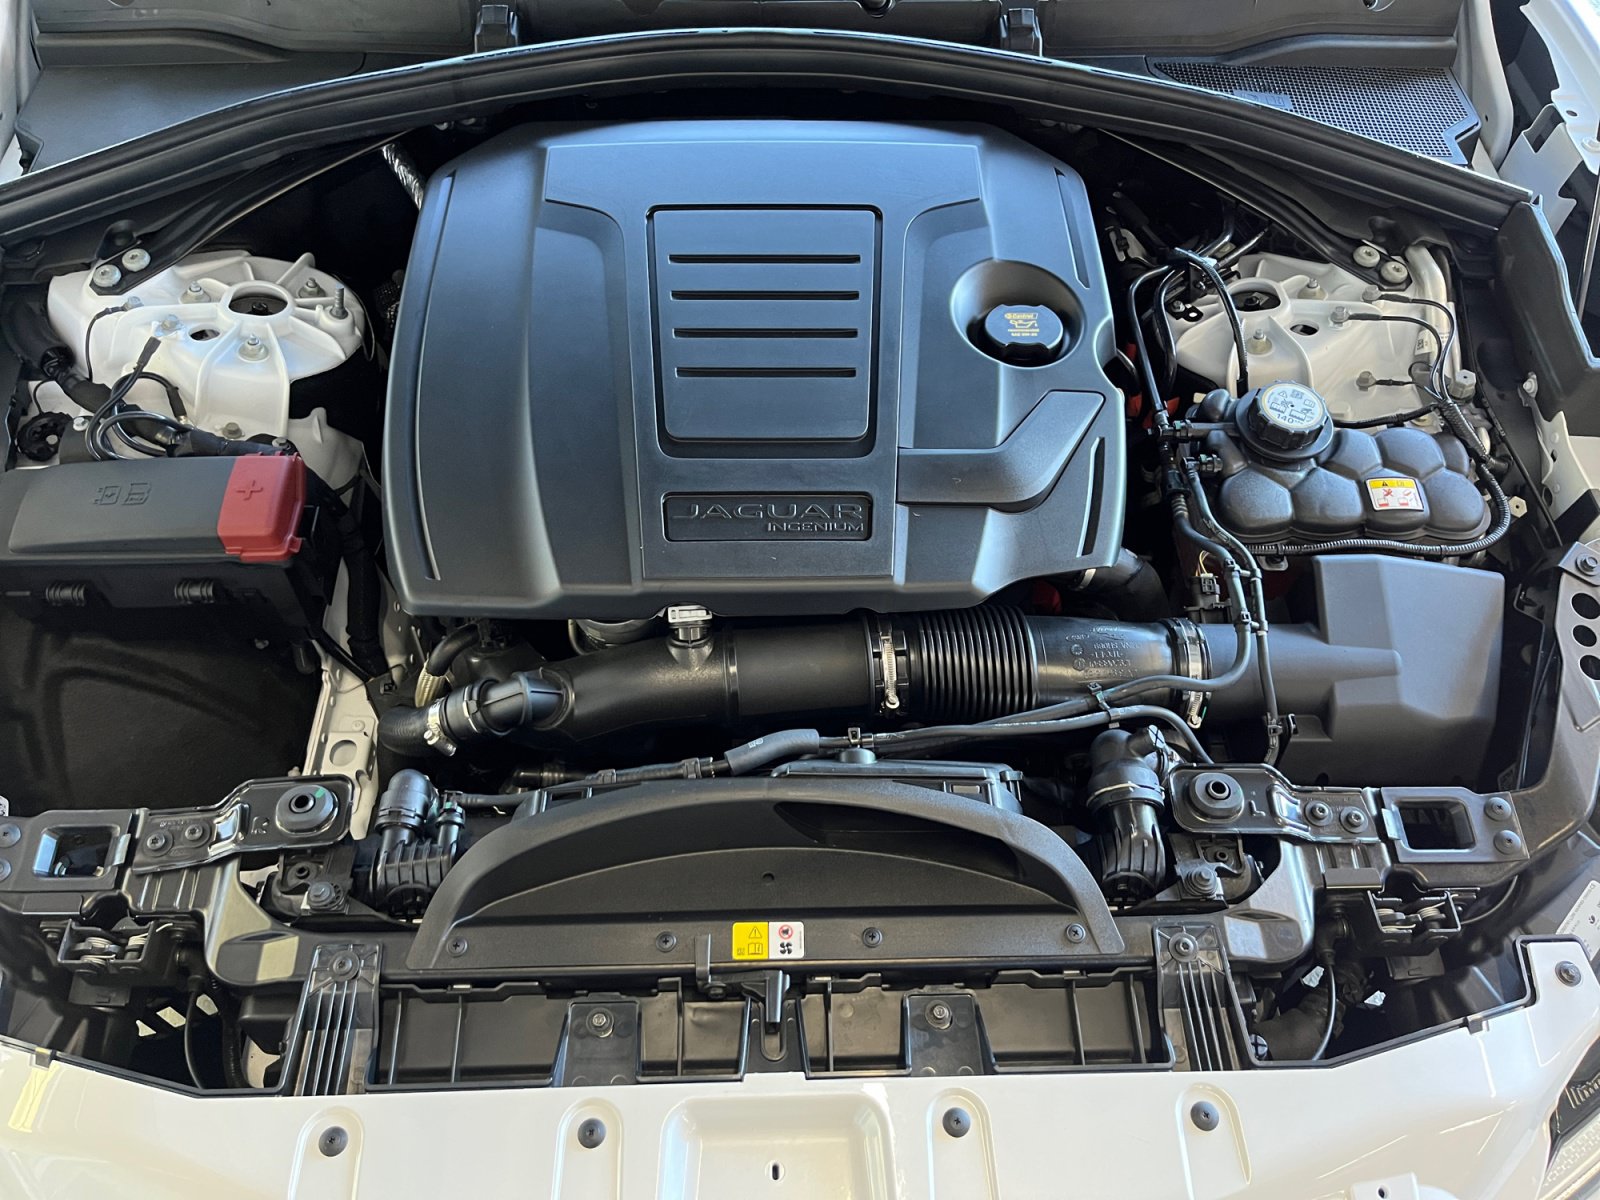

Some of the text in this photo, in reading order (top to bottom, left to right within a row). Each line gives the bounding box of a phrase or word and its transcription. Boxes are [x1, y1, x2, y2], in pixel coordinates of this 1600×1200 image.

[1277, 413, 1294, 424] 140
[673, 503, 863, 519] JAGUAR
[767, 522, 865, 532] INGENIUM
